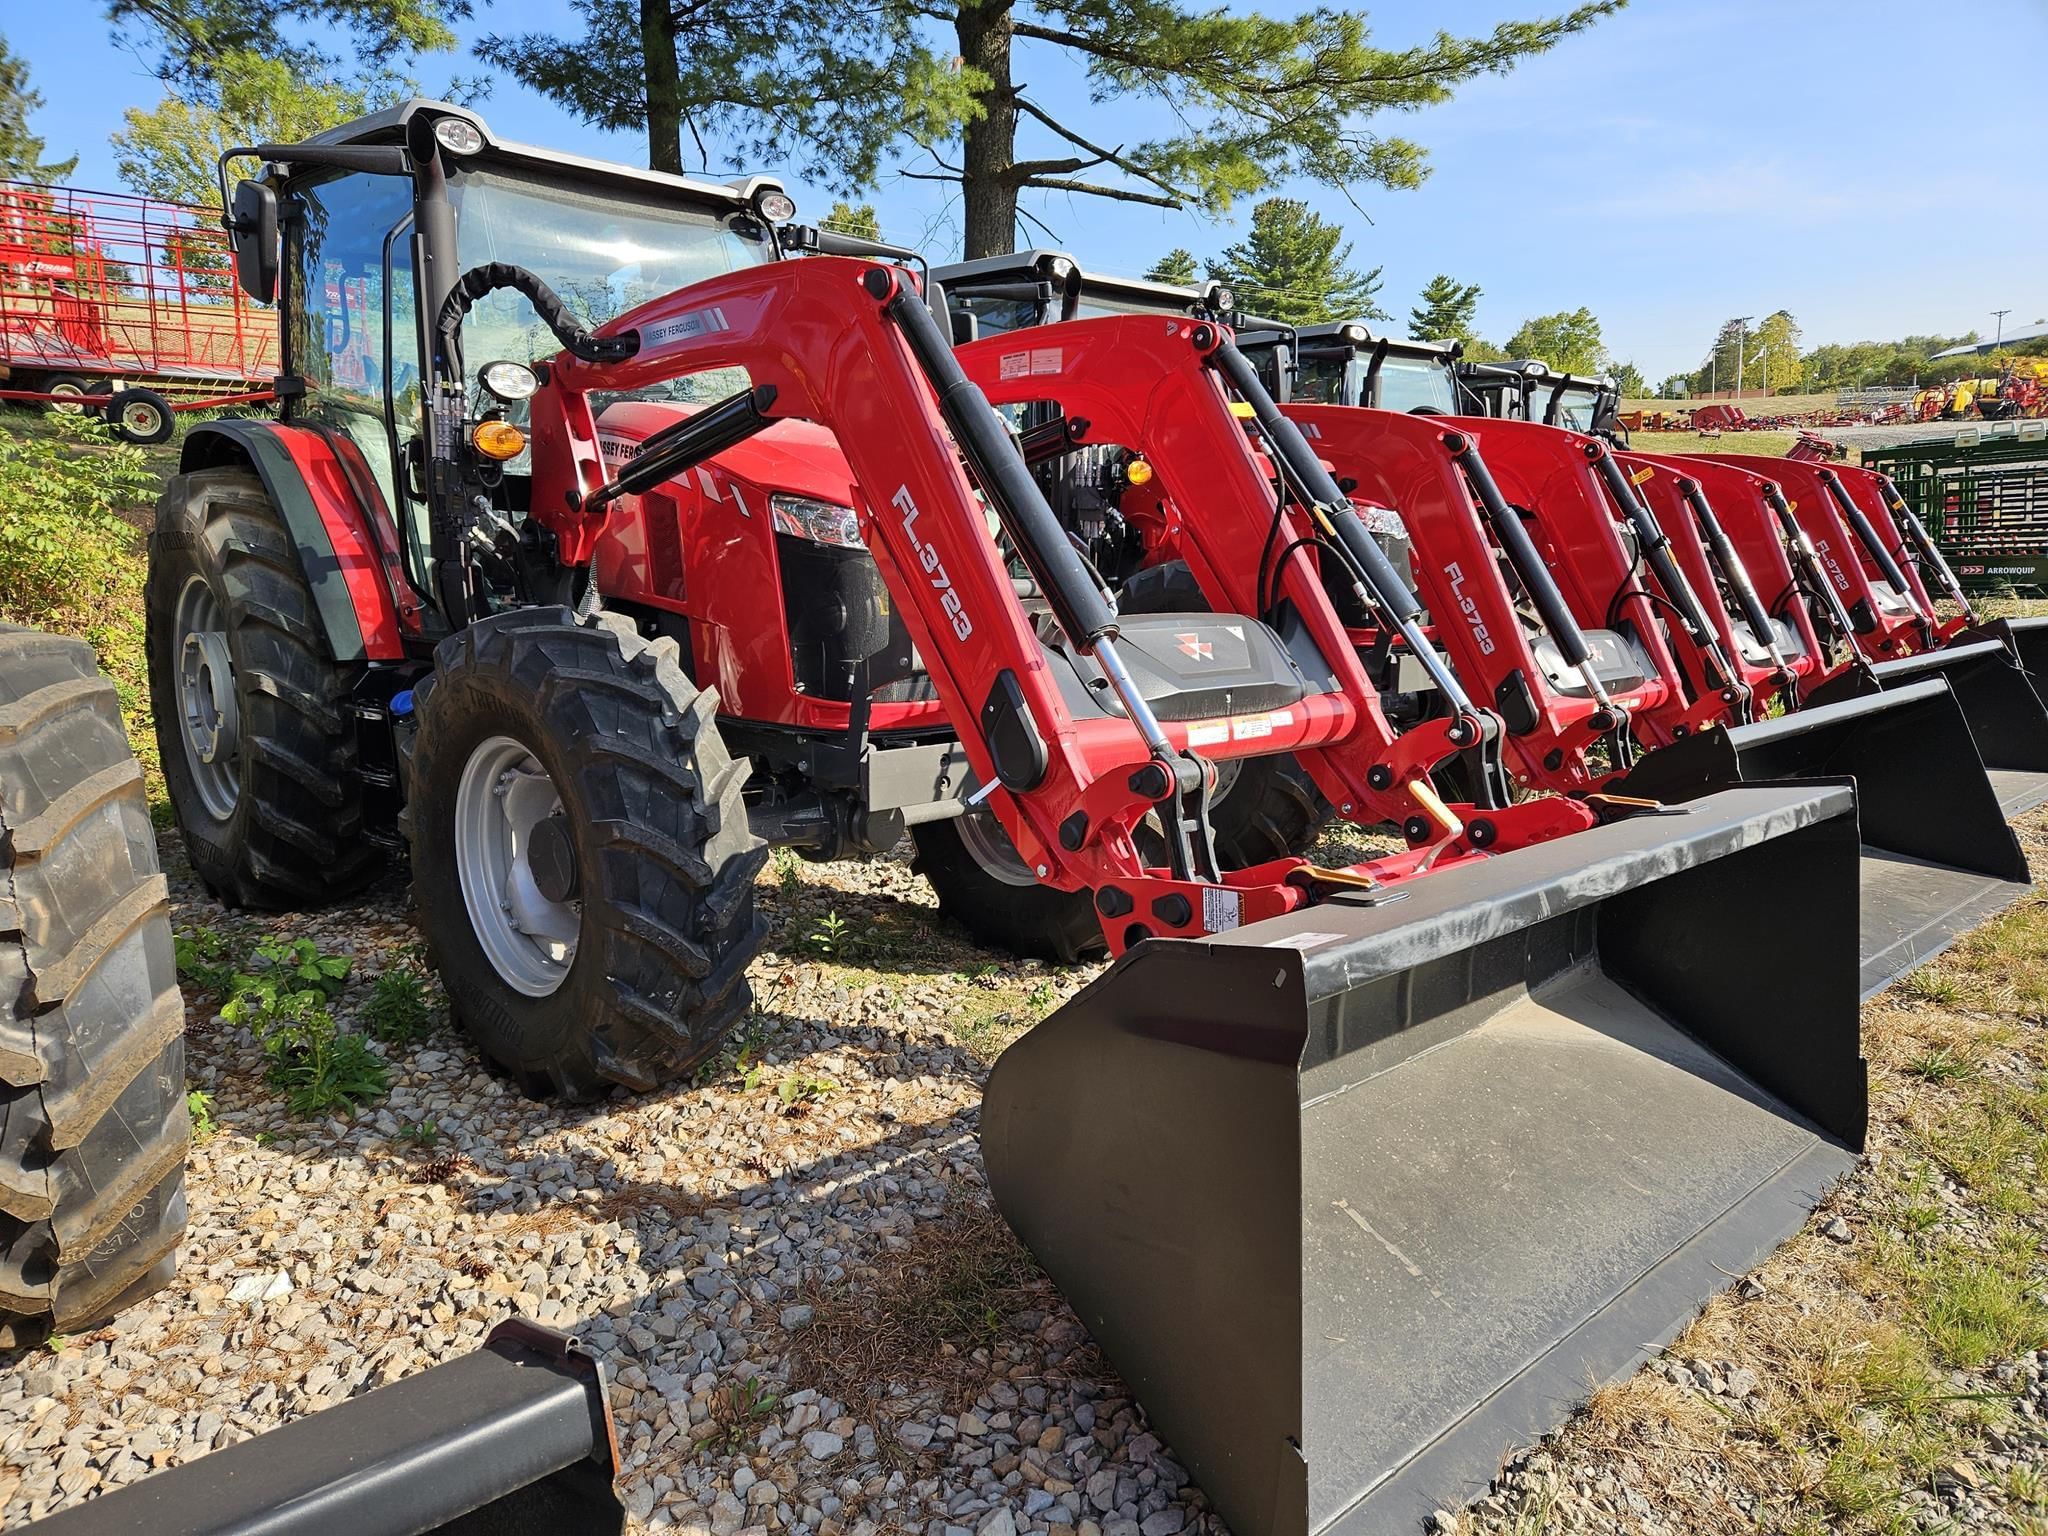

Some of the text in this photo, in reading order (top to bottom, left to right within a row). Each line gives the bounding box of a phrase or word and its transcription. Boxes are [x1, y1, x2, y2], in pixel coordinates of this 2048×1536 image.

[668, 320, 701, 337] FERGUSON
[600, 441, 620, 457] SSEY
[891, 483, 973, 642] FL.3723
[1987, 566, 2036, 576] ARROWQUIP
[1443, 561, 1496, 656] FL.3723
